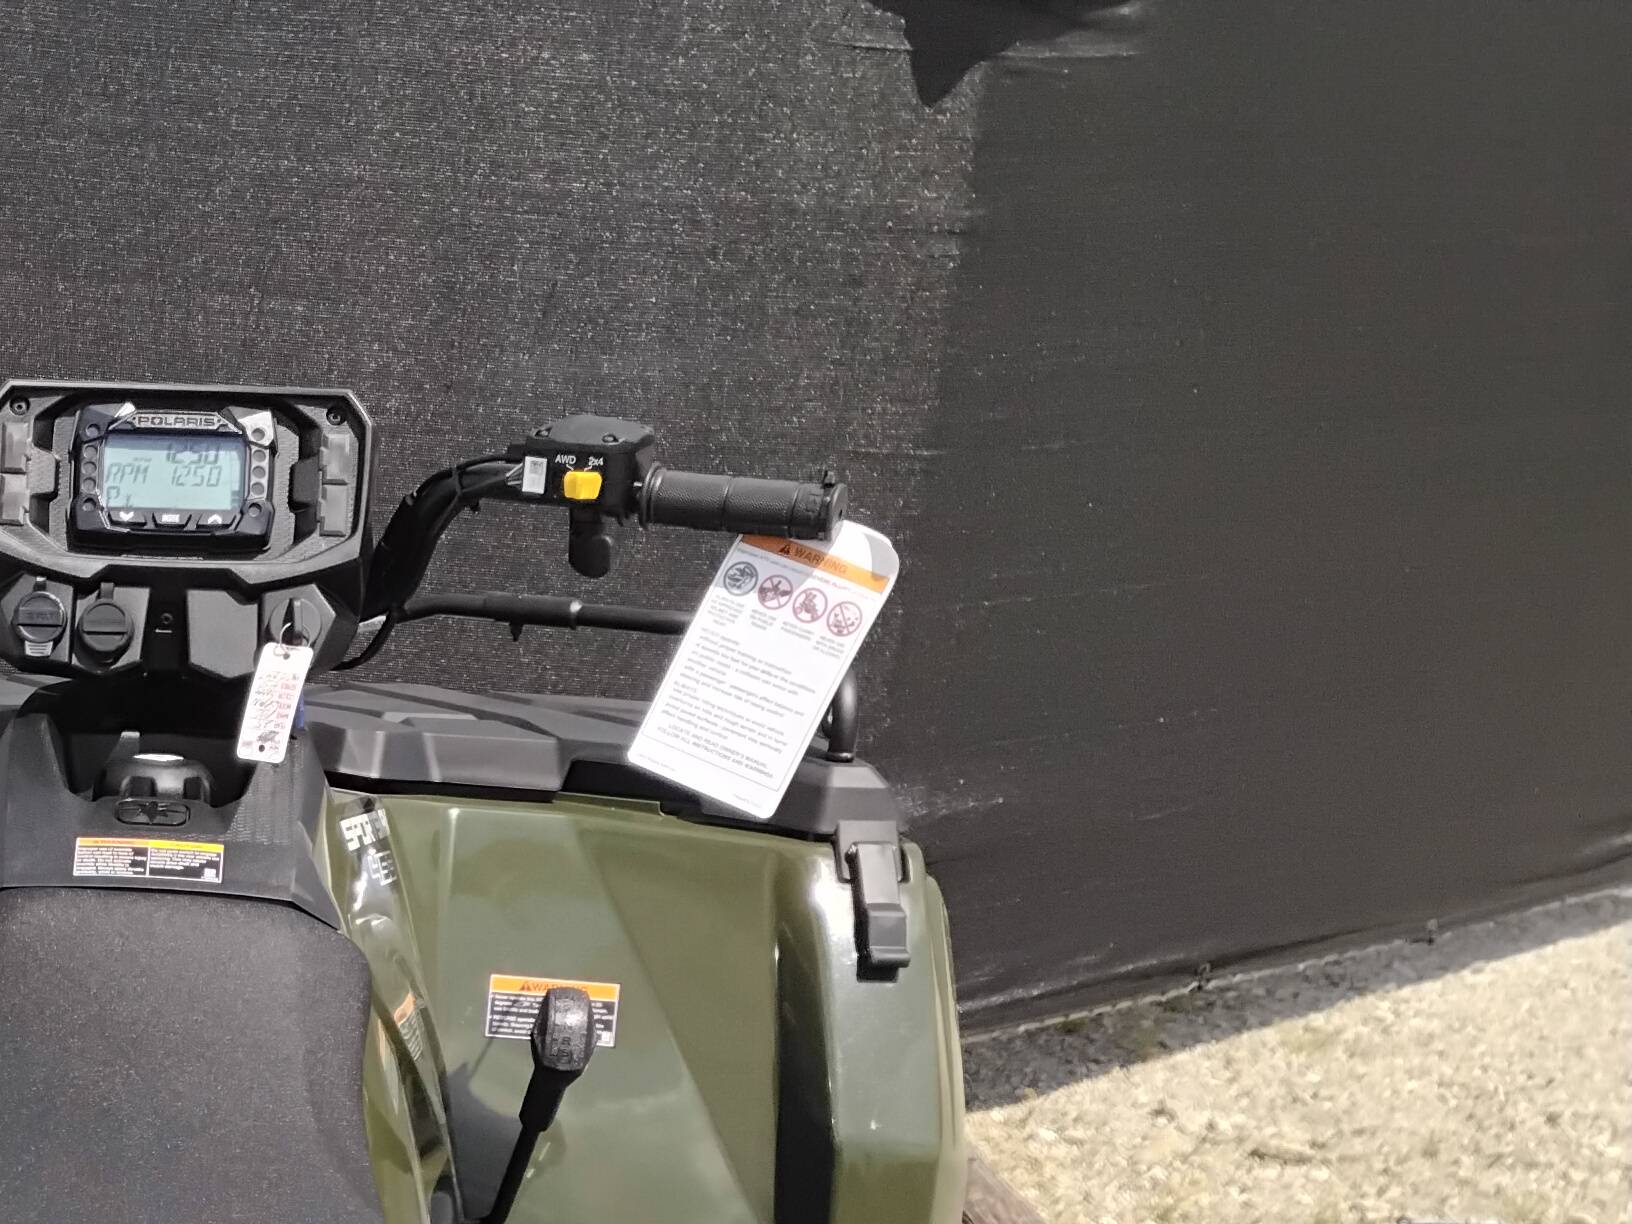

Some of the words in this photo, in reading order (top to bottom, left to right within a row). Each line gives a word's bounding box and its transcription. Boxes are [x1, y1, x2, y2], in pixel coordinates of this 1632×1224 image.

[138, 417, 214, 426] POLARIS
[167, 442, 220, 465] 1250
[555, 454, 576, 464] AWD
[588, 457, 604, 466] 2x4
[106, 463, 150, 484] RPM
[171, 465, 222, 487] 1250
[107, 486, 120, 507] P
[793, 546, 848, 575] WARNING
